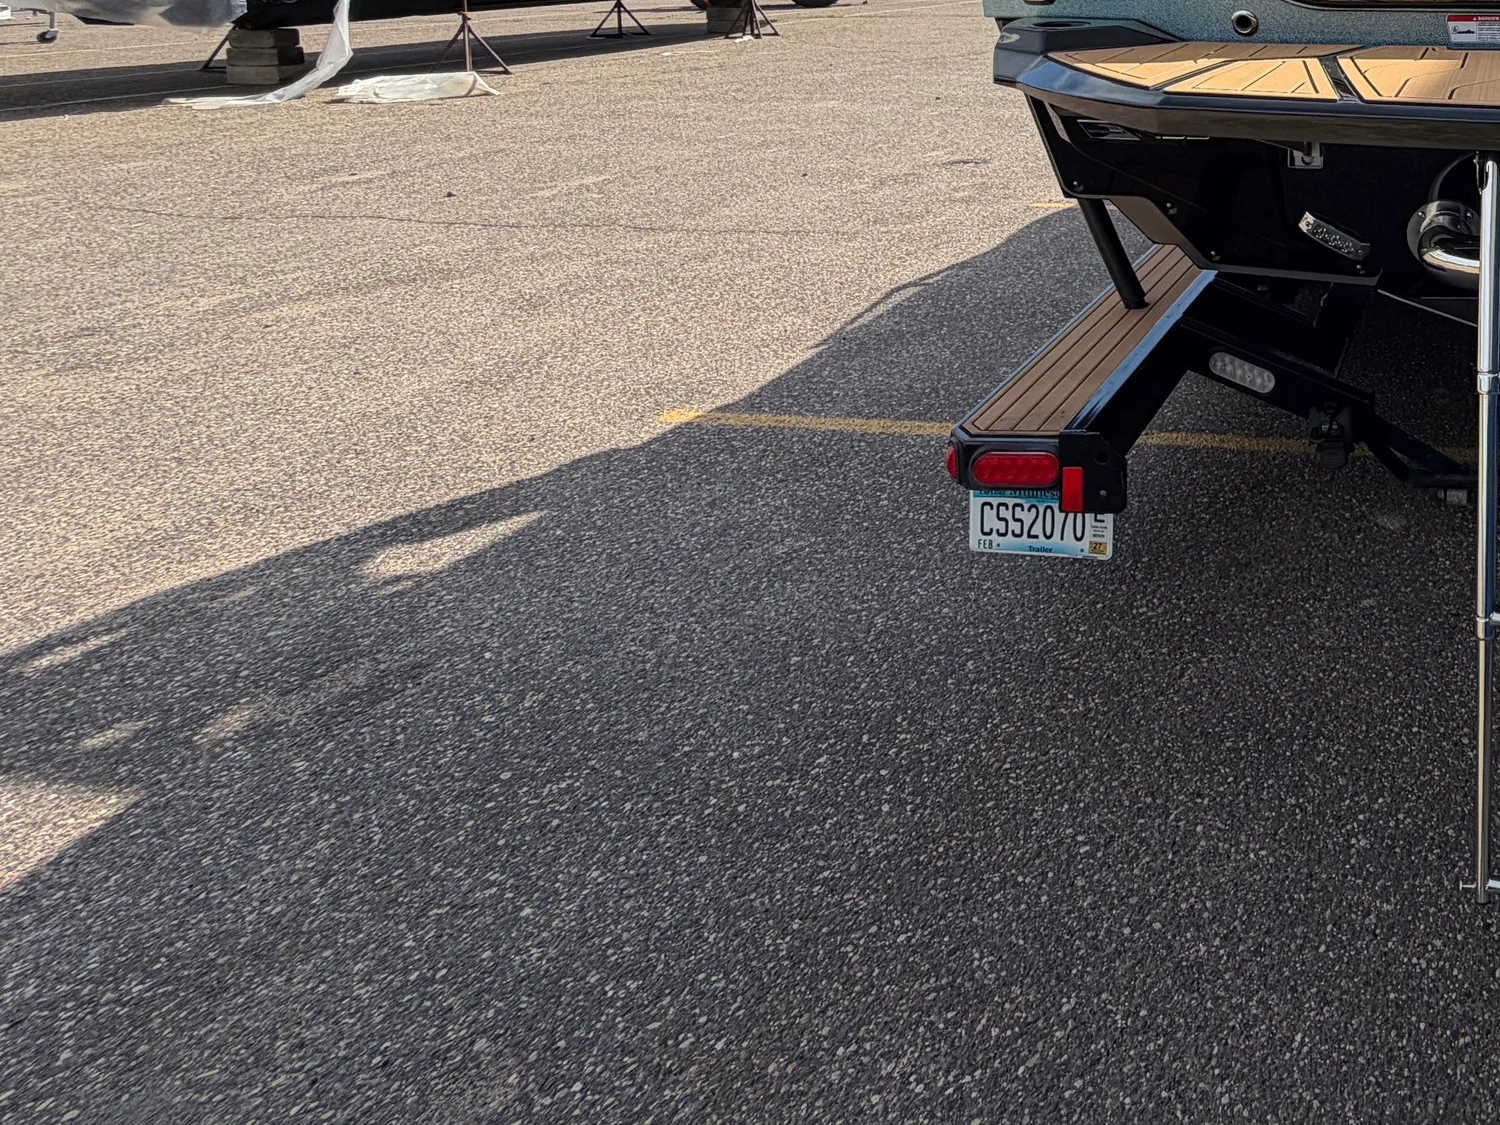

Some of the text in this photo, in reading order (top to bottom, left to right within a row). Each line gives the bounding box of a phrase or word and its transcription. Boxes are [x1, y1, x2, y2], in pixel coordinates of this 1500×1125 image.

[980, 501, 1086, 543] CSS2070
[977, 538, 994, 549] FEB
[1028, 545, 1053, 553] Trailer
